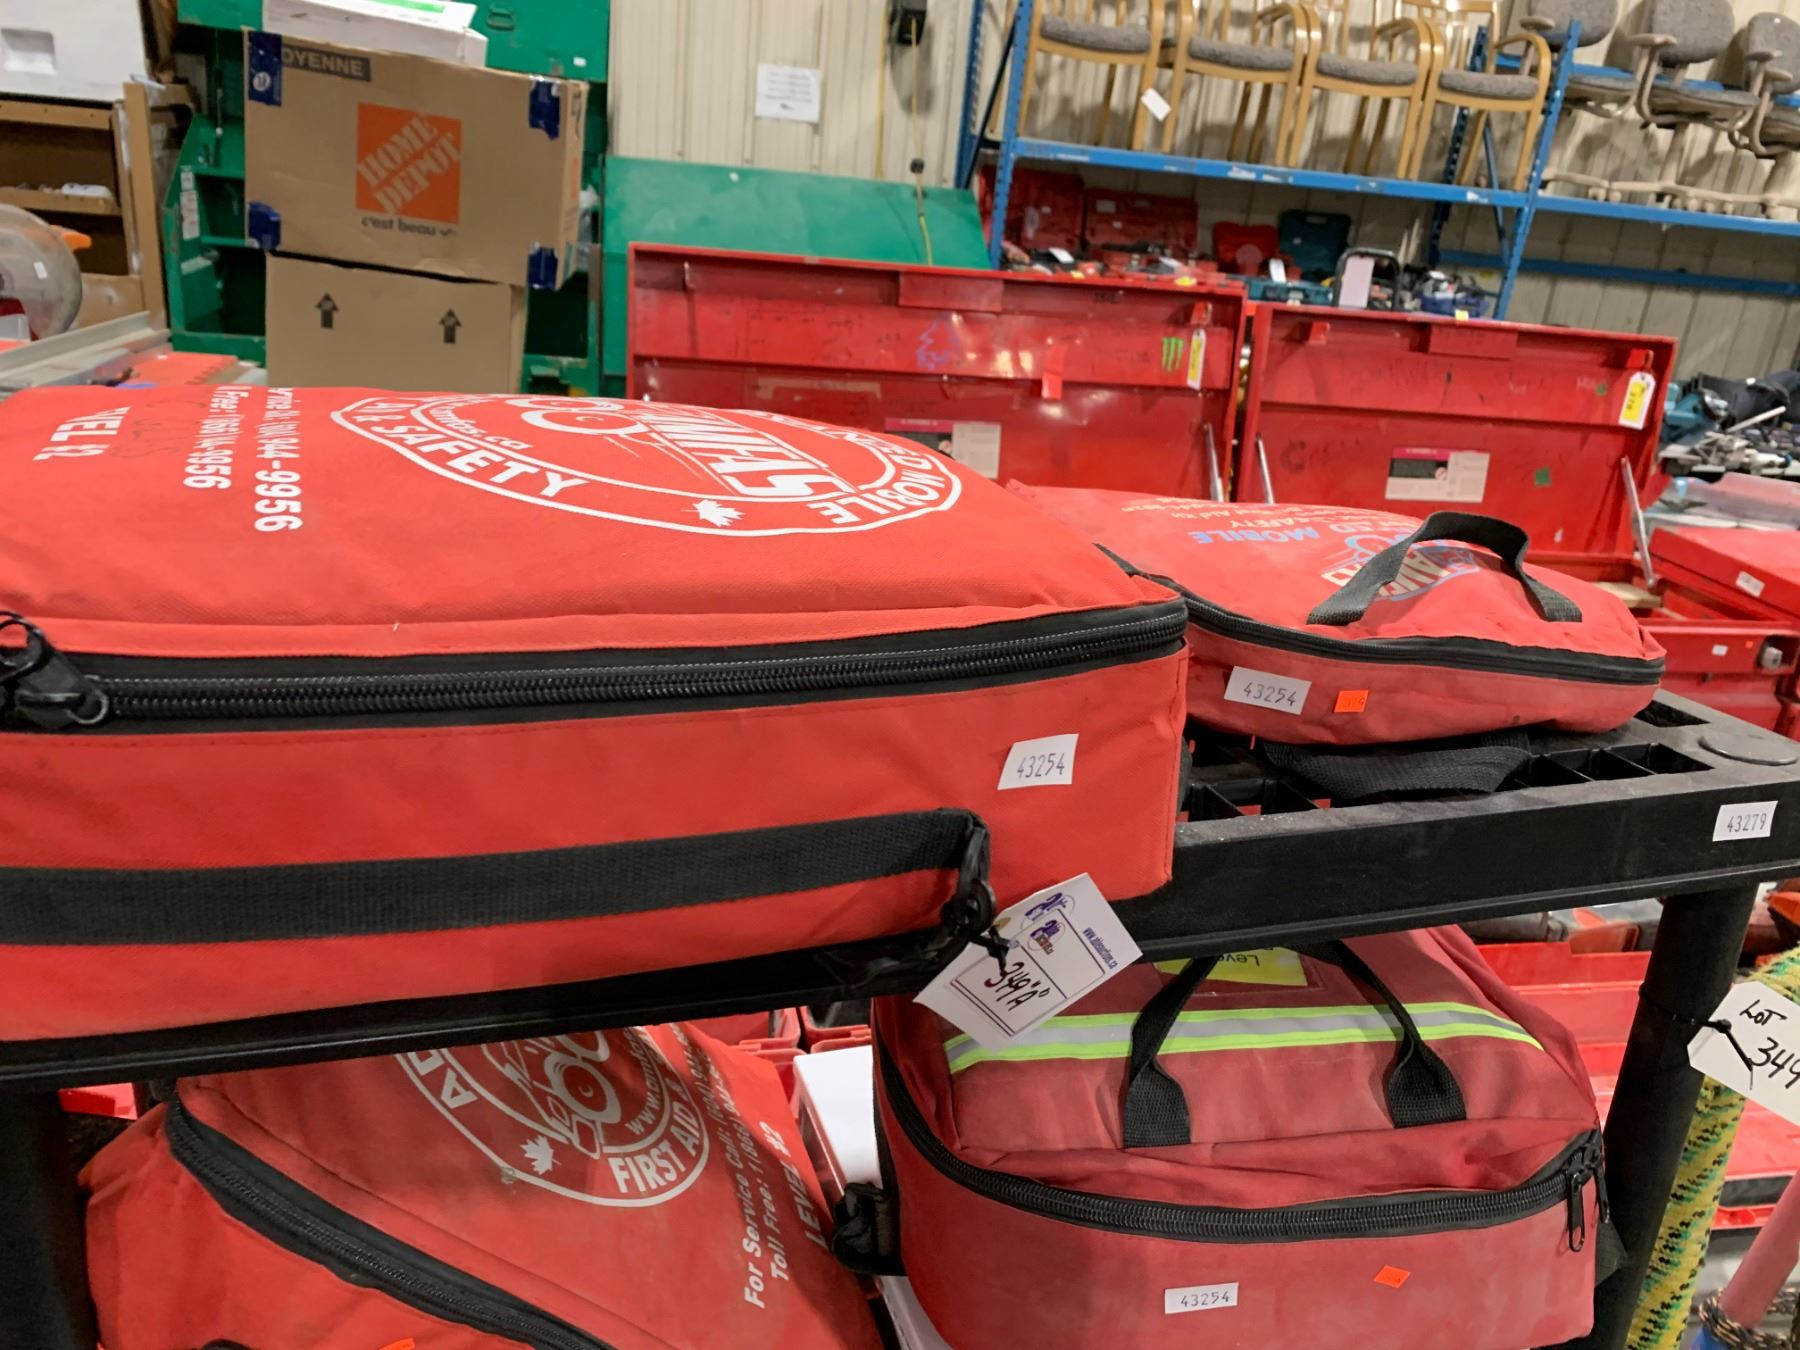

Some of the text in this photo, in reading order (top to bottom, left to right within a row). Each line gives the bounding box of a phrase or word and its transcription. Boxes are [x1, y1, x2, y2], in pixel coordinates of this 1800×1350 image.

[282, 48, 364, 77] OYENNE
[358, 116, 439, 188] HOME
[374, 132, 460, 215] DEPOT
[398, 218, 436, 236] beau
[370, 425, 591, 498] SAFETY
[806, 469, 946, 525] MOBILE
[1189, 525, 1321, 544] MOBILE
[1242, 681, 1297, 706] 43254
[1016, 752, 1065, 778] 43254
[1726, 812, 1768, 833] 43279
[1217, 953, 1261, 967] Leve
[607, 1142, 685, 1194] FIRST
[670, 1100, 702, 1157] AID
[717, 1126, 745, 1169] Call:
[735, 1172, 762, 1258] Service
[757, 1178, 781, 1234] Free:
[780, 1158, 830, 1253] LEVEL
[767, 1235, 790, 1281] Toll
[743, 1261, 766, 1309] For
[1180, 1290, 1230, 1308] 43254
